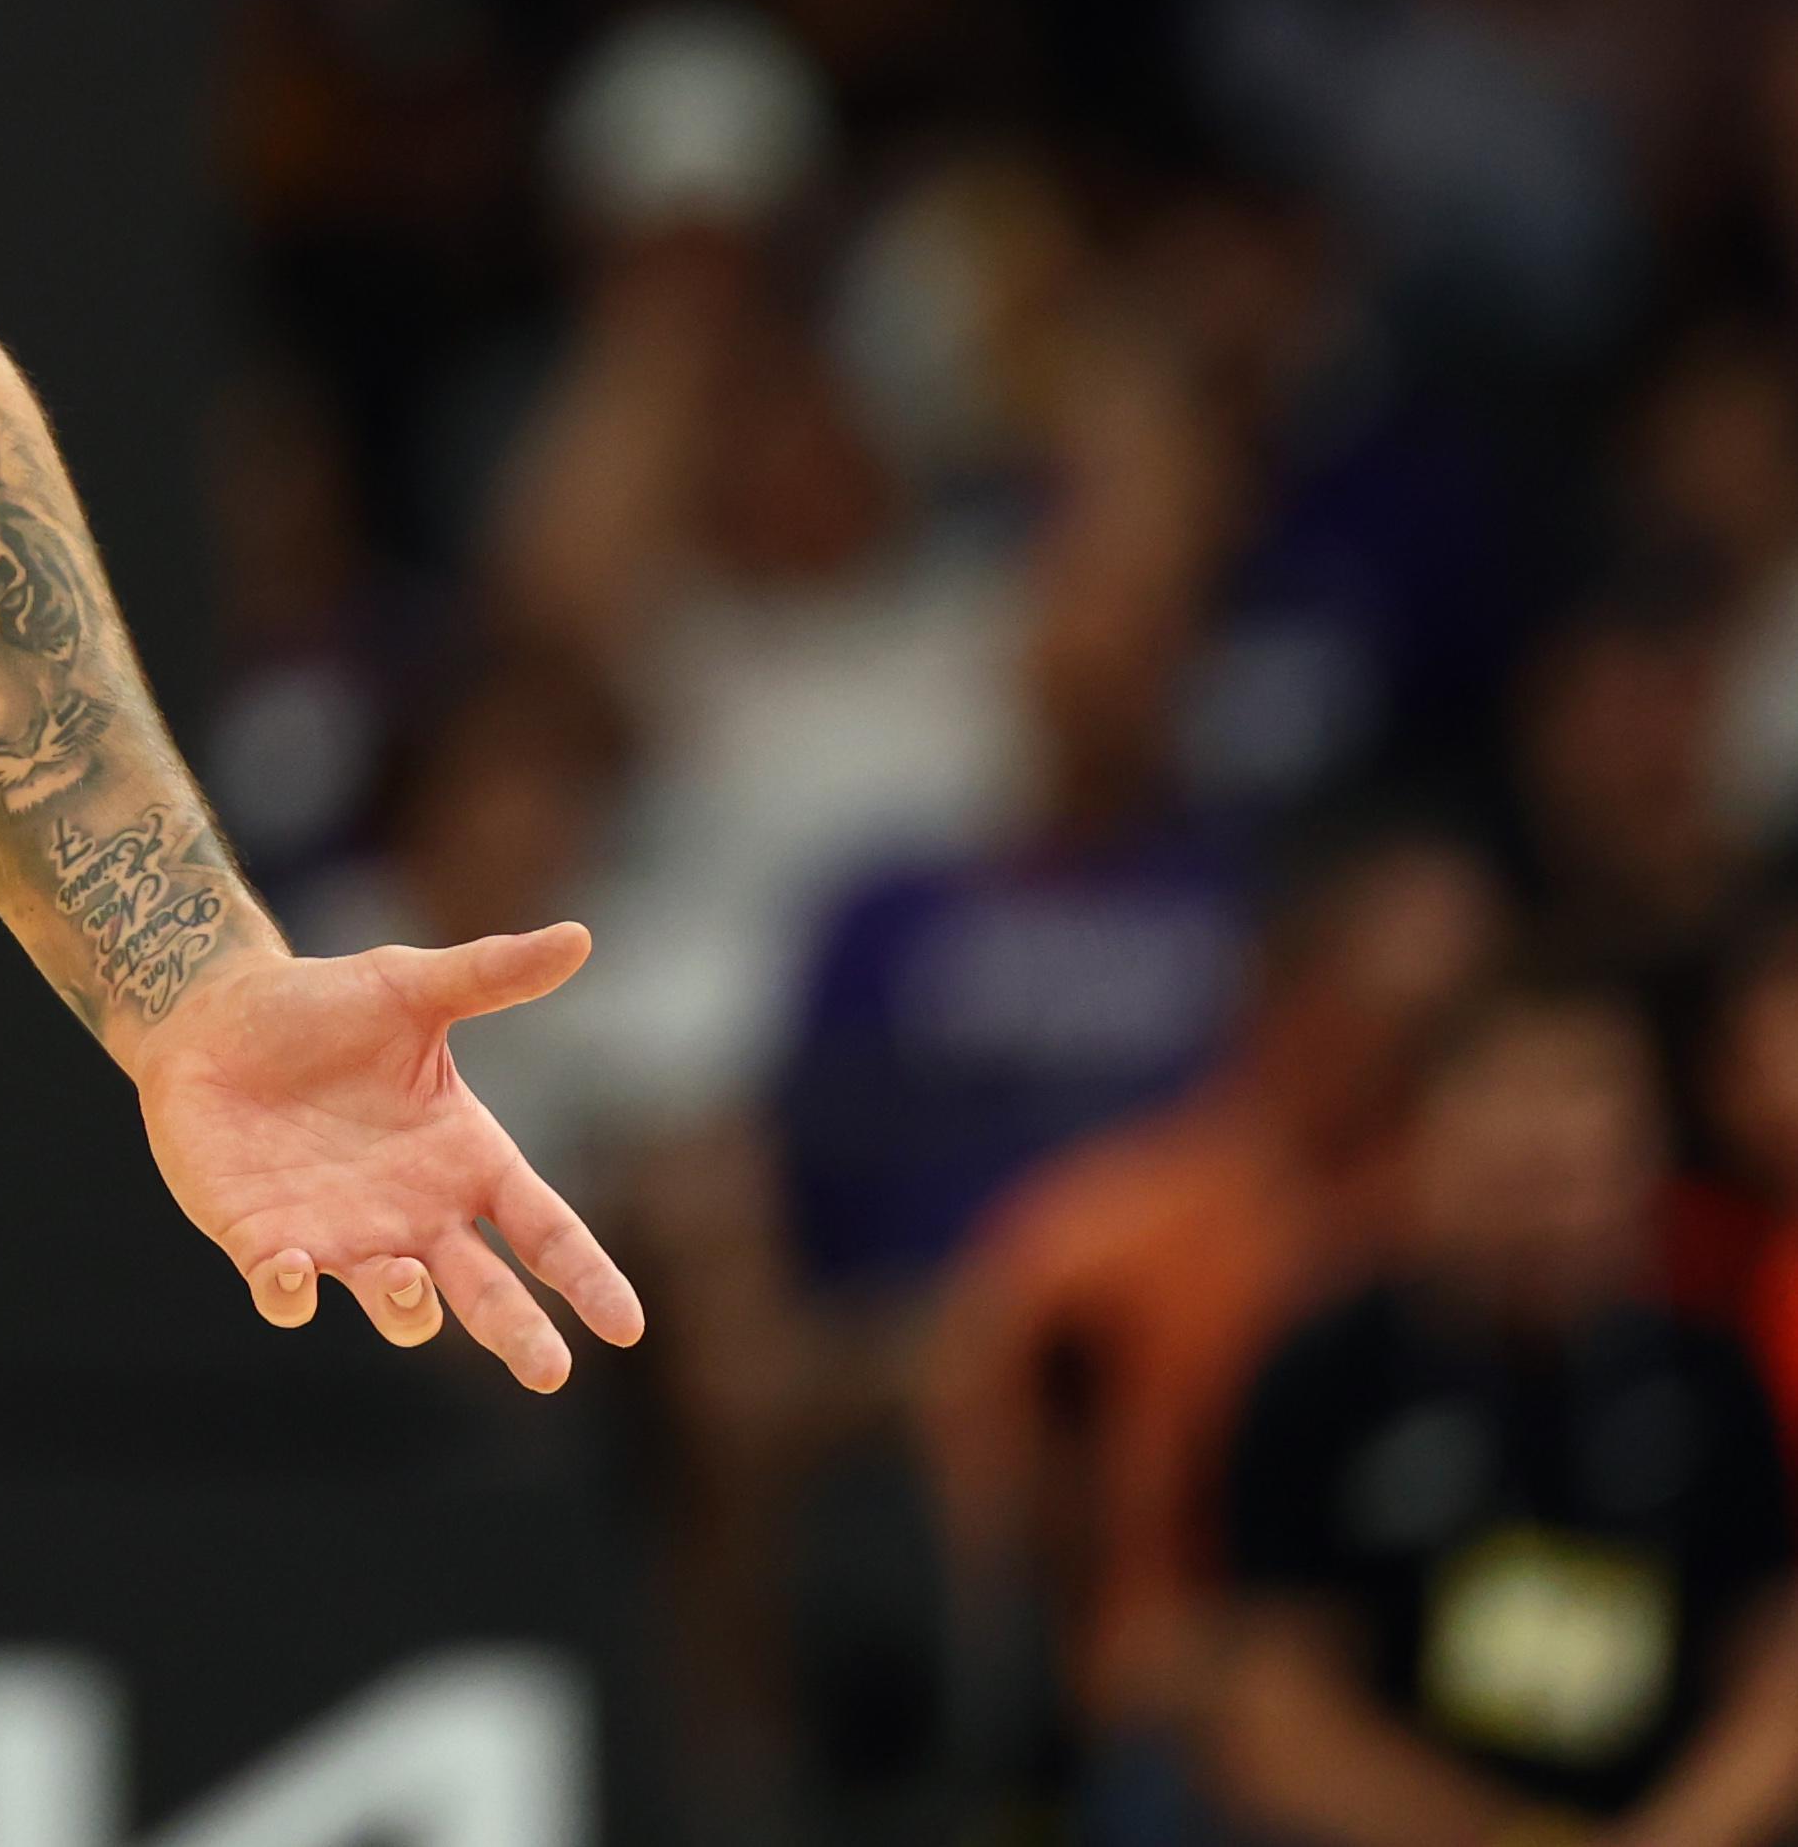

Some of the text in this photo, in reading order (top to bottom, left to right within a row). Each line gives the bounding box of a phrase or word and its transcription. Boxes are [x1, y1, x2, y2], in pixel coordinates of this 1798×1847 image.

[55, 817, 94, 870] 7
[88, 873, 161, 955] Non
[139, 933, 210, 1014] Non
